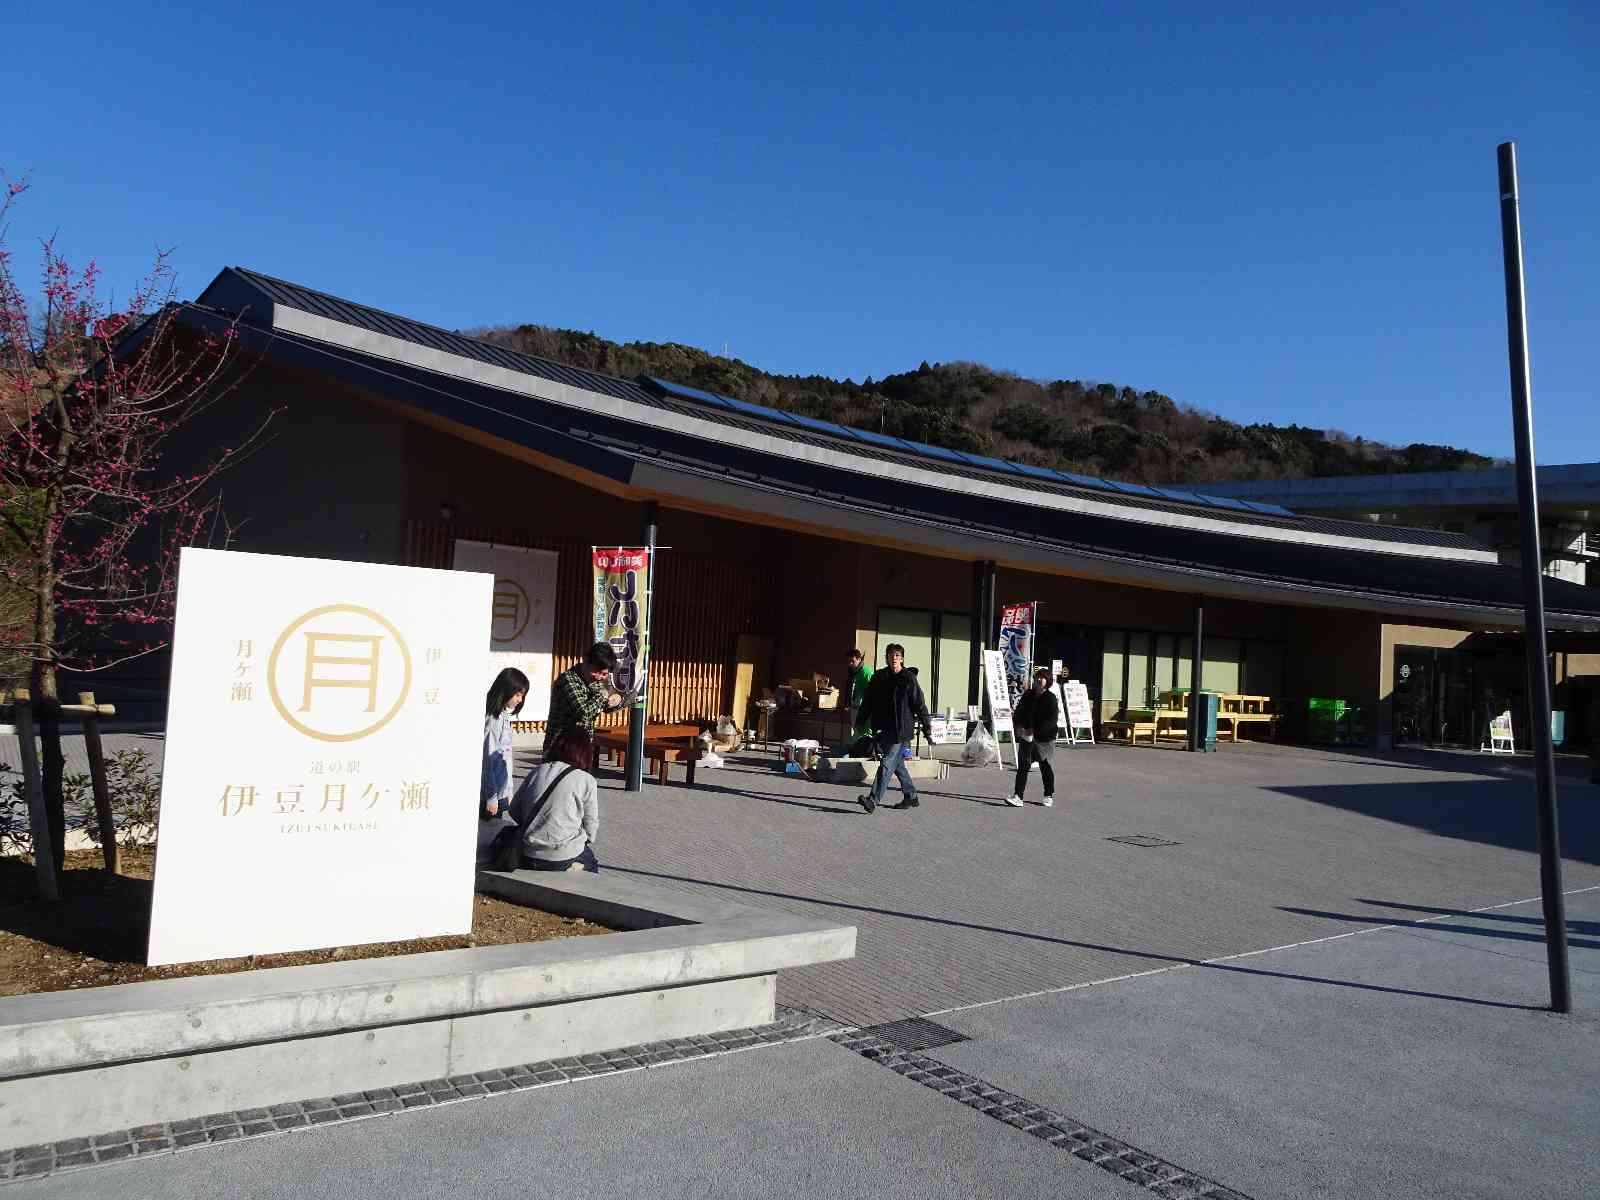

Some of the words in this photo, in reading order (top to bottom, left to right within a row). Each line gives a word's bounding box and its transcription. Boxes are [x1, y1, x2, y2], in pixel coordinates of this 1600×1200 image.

[297, 631, 386, 713] 月
[423, 646, 443, 705] 伊豆
[308, 759, 361, 776] 道の駅
